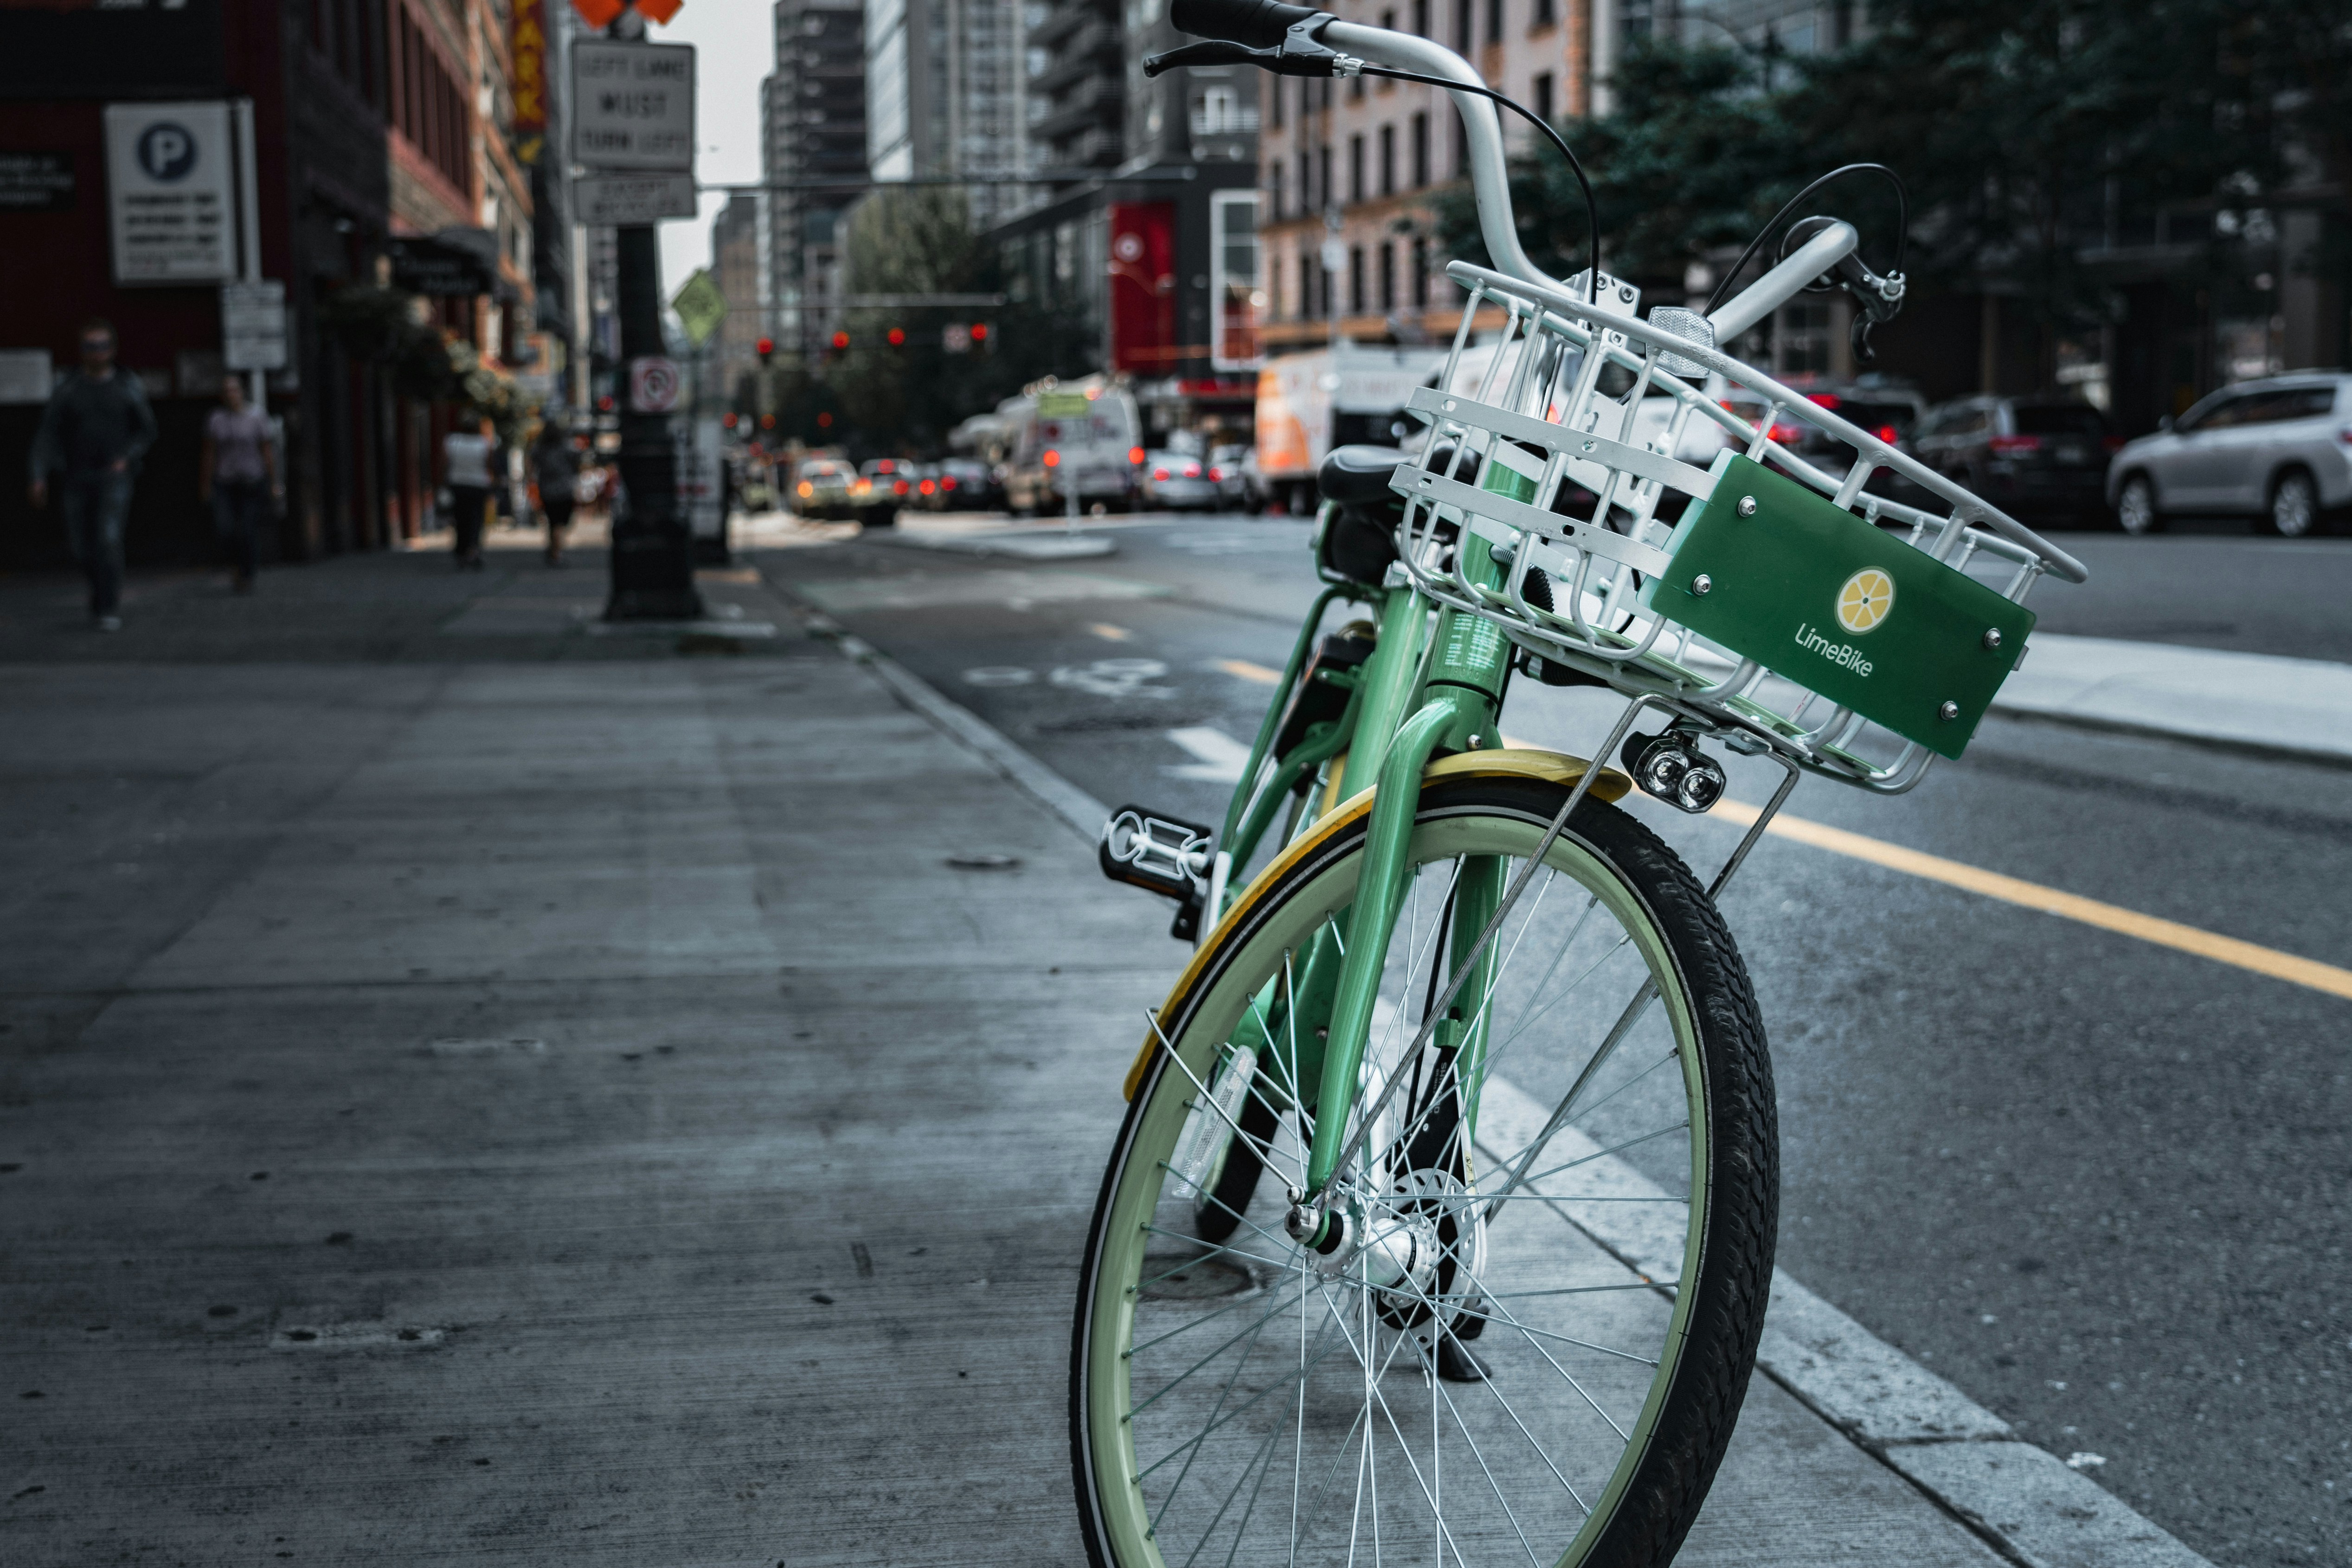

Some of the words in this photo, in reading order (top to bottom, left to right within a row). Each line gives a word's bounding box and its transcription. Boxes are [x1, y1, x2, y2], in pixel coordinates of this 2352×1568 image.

[599, 92, 667, 119] MUST
[149, 129, 187, 175] P
[1795, 623, 1873, 677] LimeBike
[1433, 1062, 1447, 1114] SHIO
